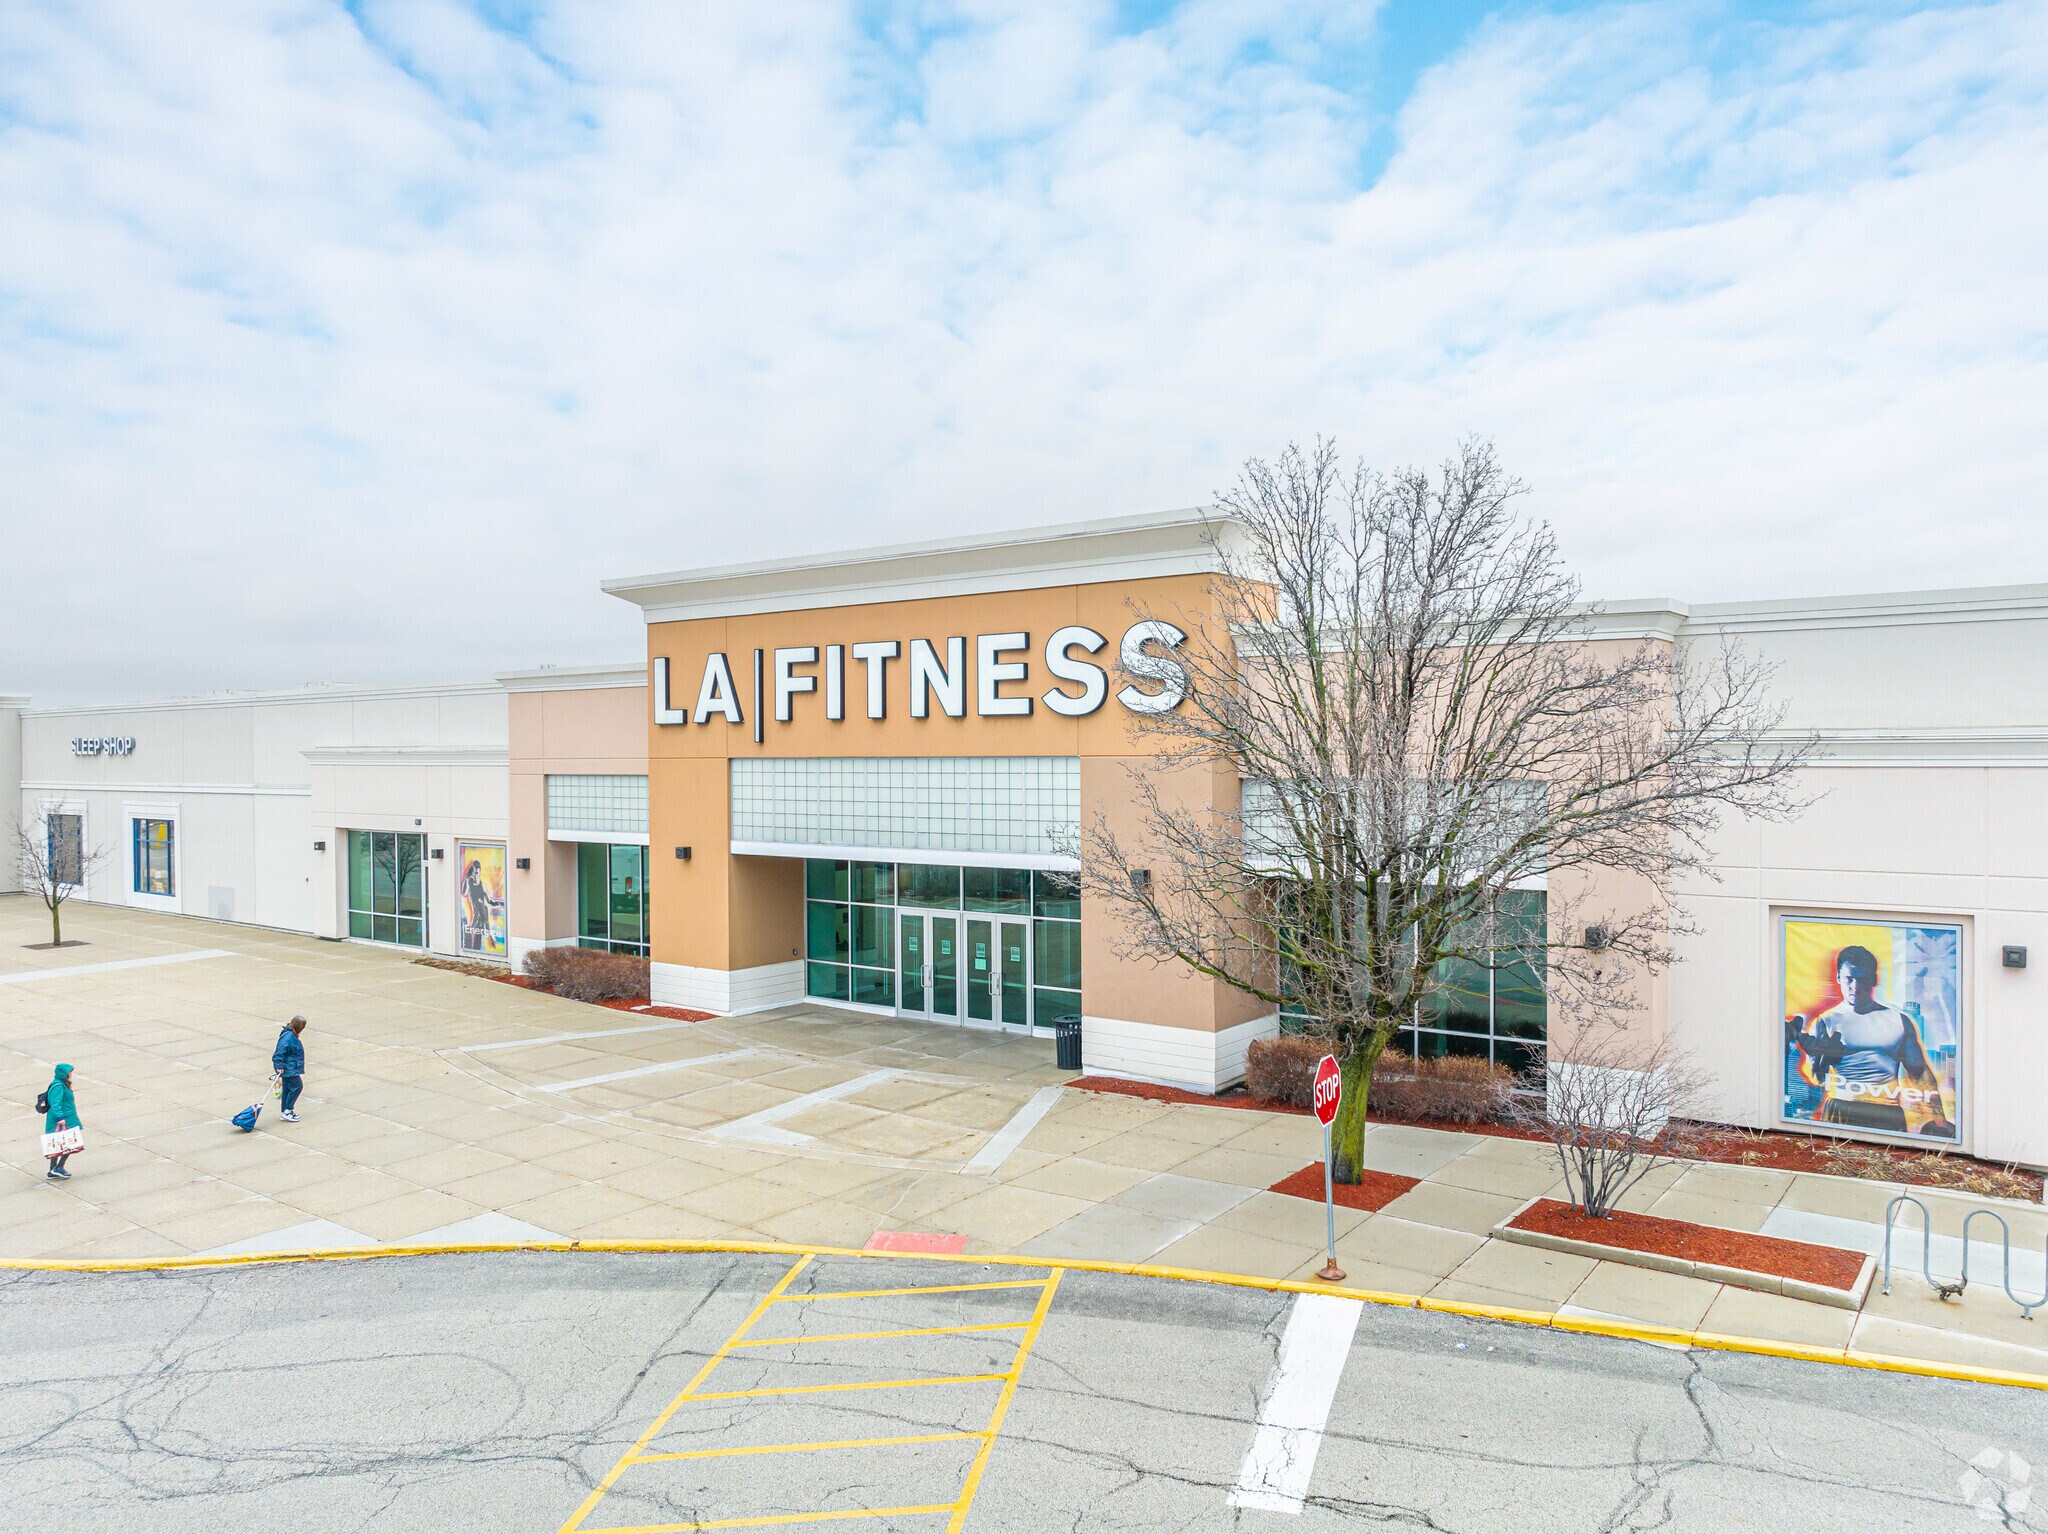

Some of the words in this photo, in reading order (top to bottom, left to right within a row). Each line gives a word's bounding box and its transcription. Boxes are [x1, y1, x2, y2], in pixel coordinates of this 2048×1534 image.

[774, 619, 1190, 722] FITNESS
[71, 738, 101, 755] SLEEP
[102, 737, 134, 755] SHOP
[1316, 1073, 1339, 1109] STOP
[1825, 1073, 1938, 1103] Power
